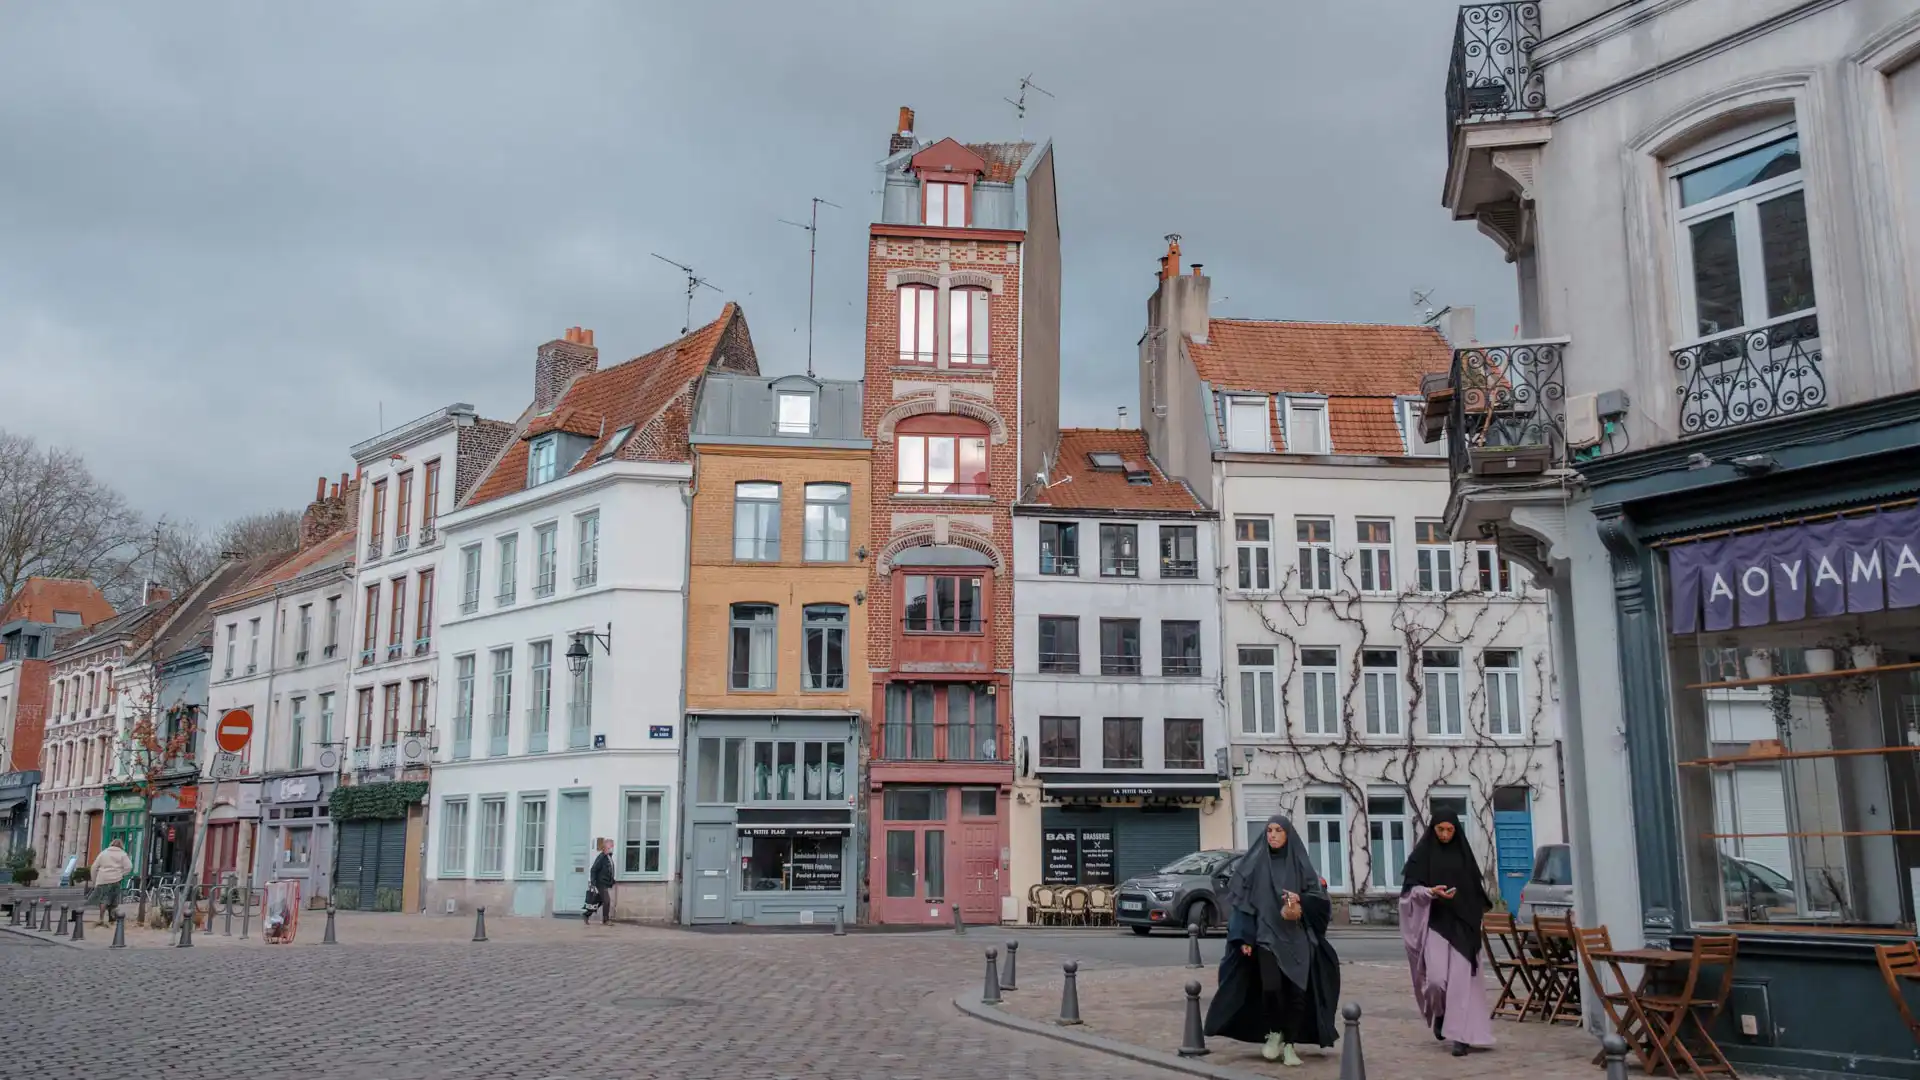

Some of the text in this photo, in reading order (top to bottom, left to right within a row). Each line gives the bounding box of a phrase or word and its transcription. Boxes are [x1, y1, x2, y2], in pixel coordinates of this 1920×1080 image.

[1709, 544, 1920, 603] AOYAMA
[221, 754, 236, 762] SAUF
[1045, 833, 1076, 841] BAR
[1082, 832, 1110, 841] BRASSERIE
